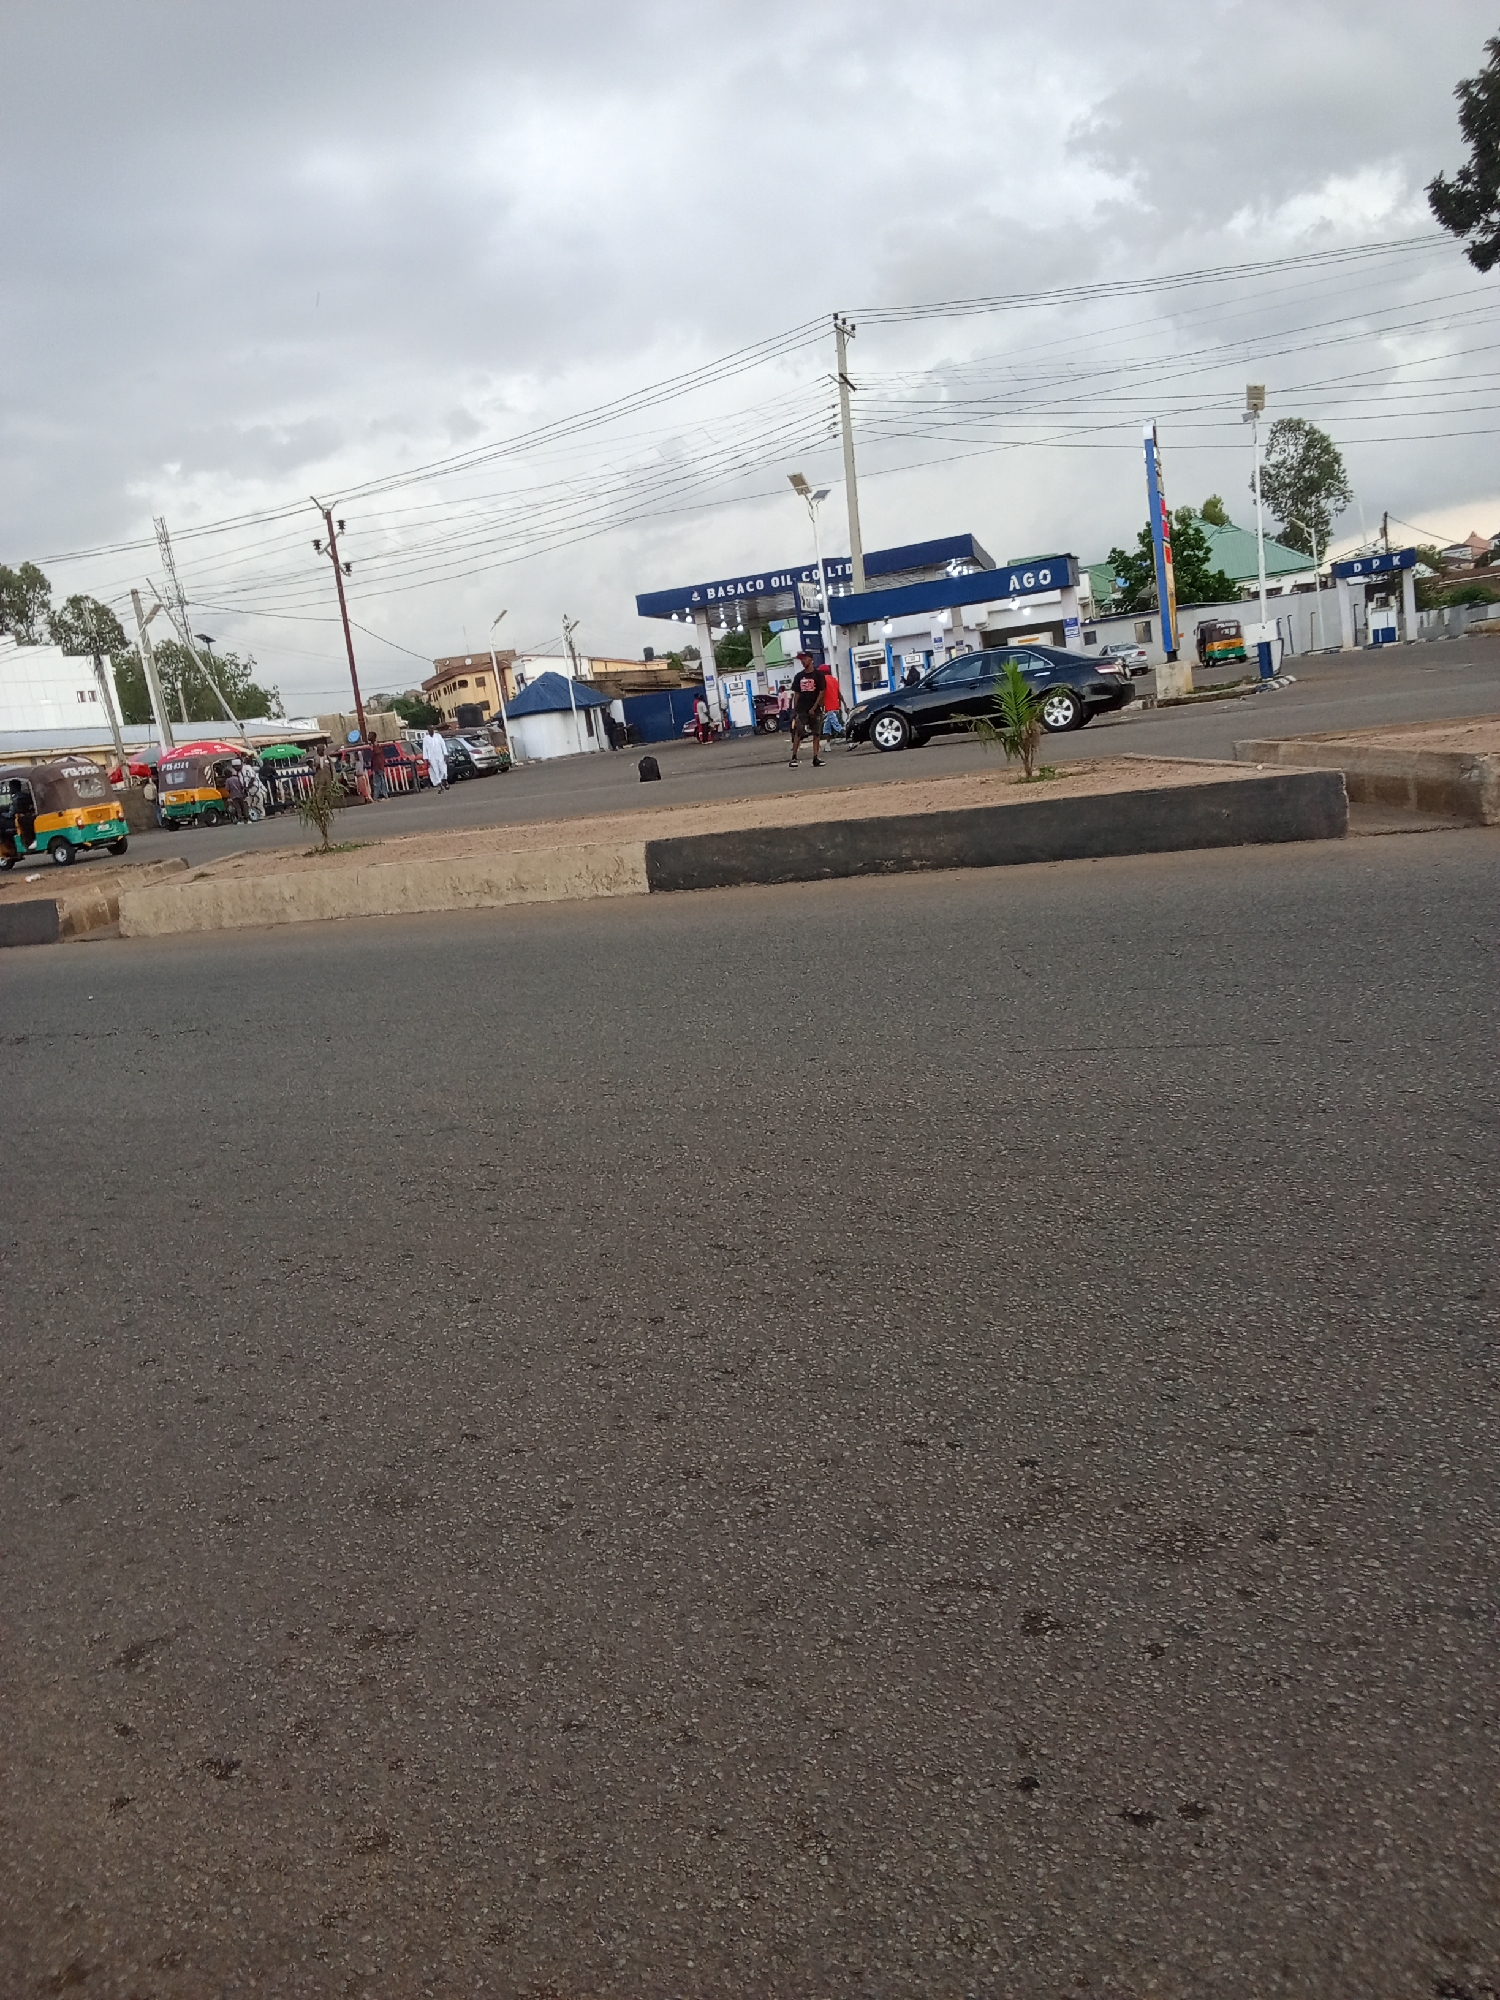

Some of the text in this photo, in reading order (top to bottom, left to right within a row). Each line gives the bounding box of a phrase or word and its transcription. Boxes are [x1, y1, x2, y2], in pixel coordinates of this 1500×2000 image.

[706, 562, 853, 599] BASACO OIL CO LTD
[1009, 569, 1051, 591] AGO
